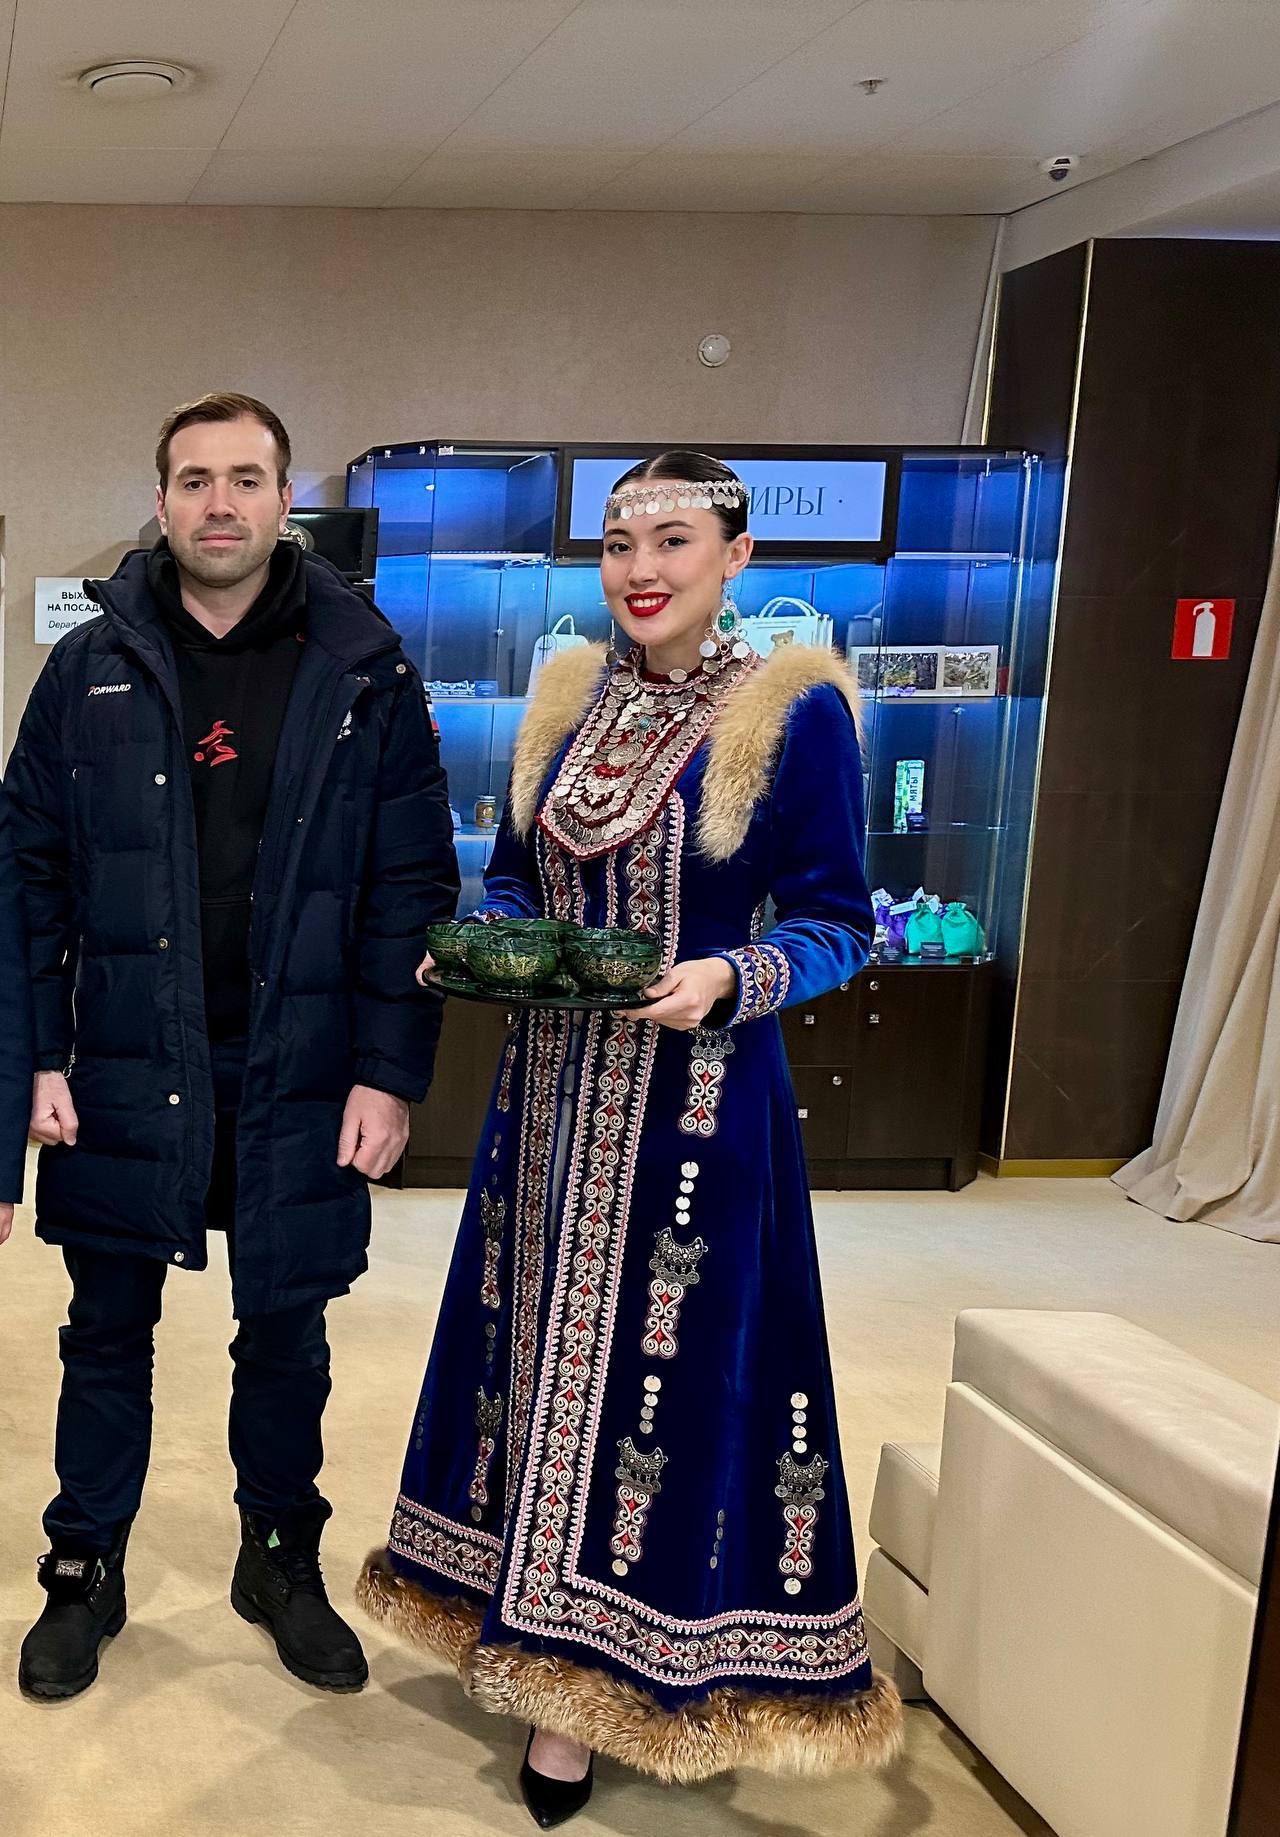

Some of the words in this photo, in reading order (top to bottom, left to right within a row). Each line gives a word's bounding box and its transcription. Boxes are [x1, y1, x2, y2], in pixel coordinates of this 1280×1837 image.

[749, 486, 827, 516] ИРЫ
[61, 591, 88, 600] ВЫХ
[47, 603, 61, 612] НА
[63, 603, 101, 613] ПОСАД
[48, 620, 79, 630] Depart
[87, 683, 132, 697] FORWARD
